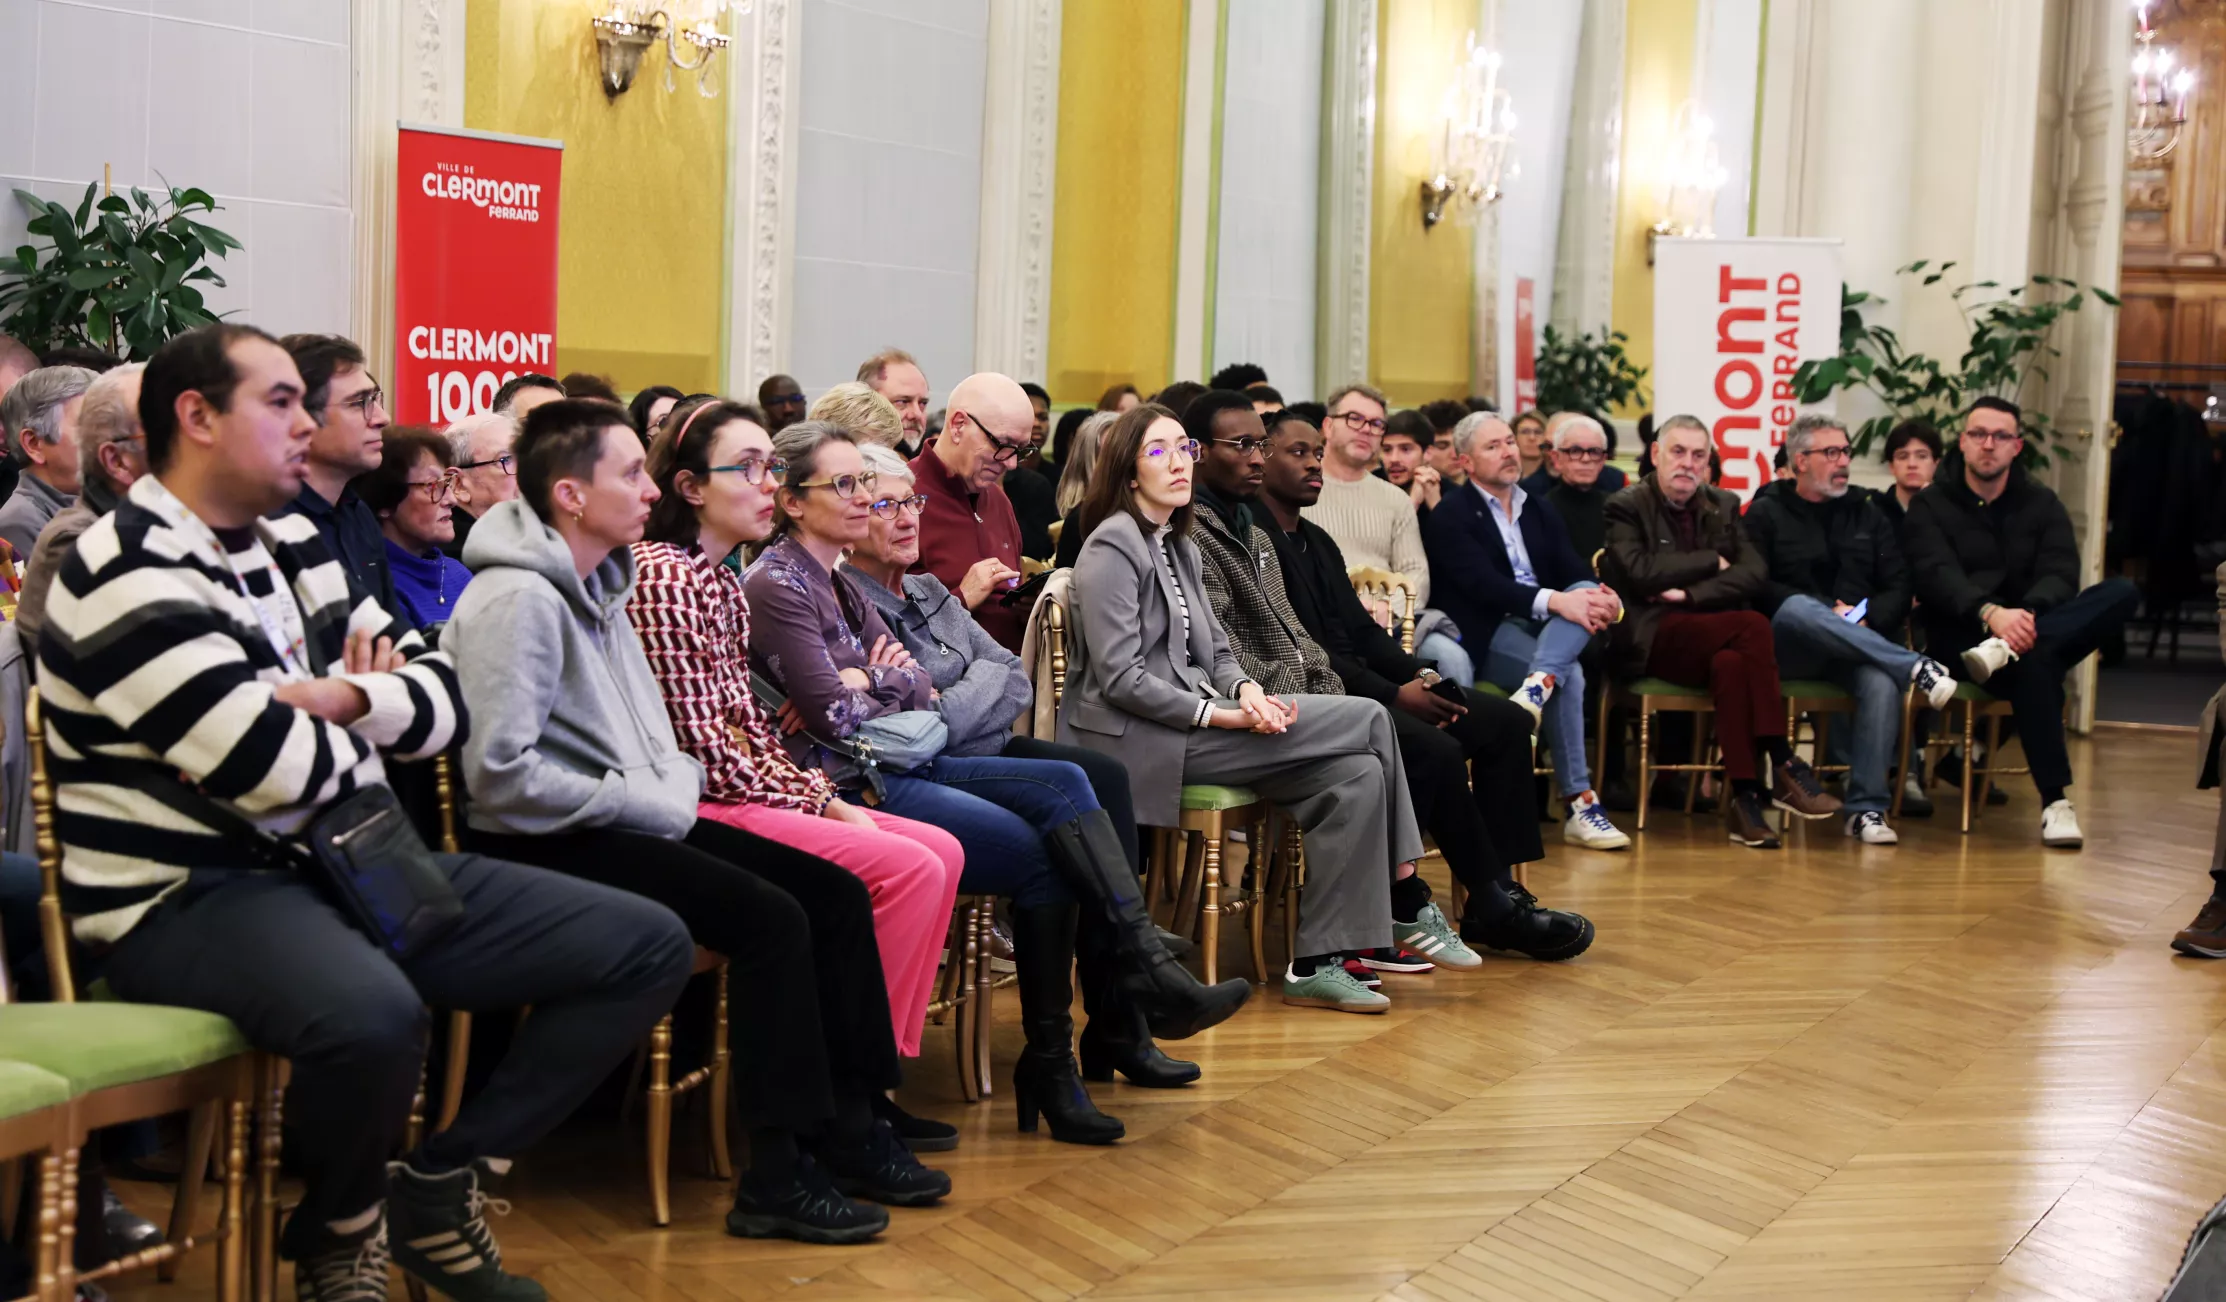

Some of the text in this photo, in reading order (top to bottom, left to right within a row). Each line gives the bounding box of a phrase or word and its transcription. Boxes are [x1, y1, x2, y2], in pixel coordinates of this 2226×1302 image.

[437, 162, 475, 174] VILLE DE
[408, 325, 552, 365] CLERMONT
